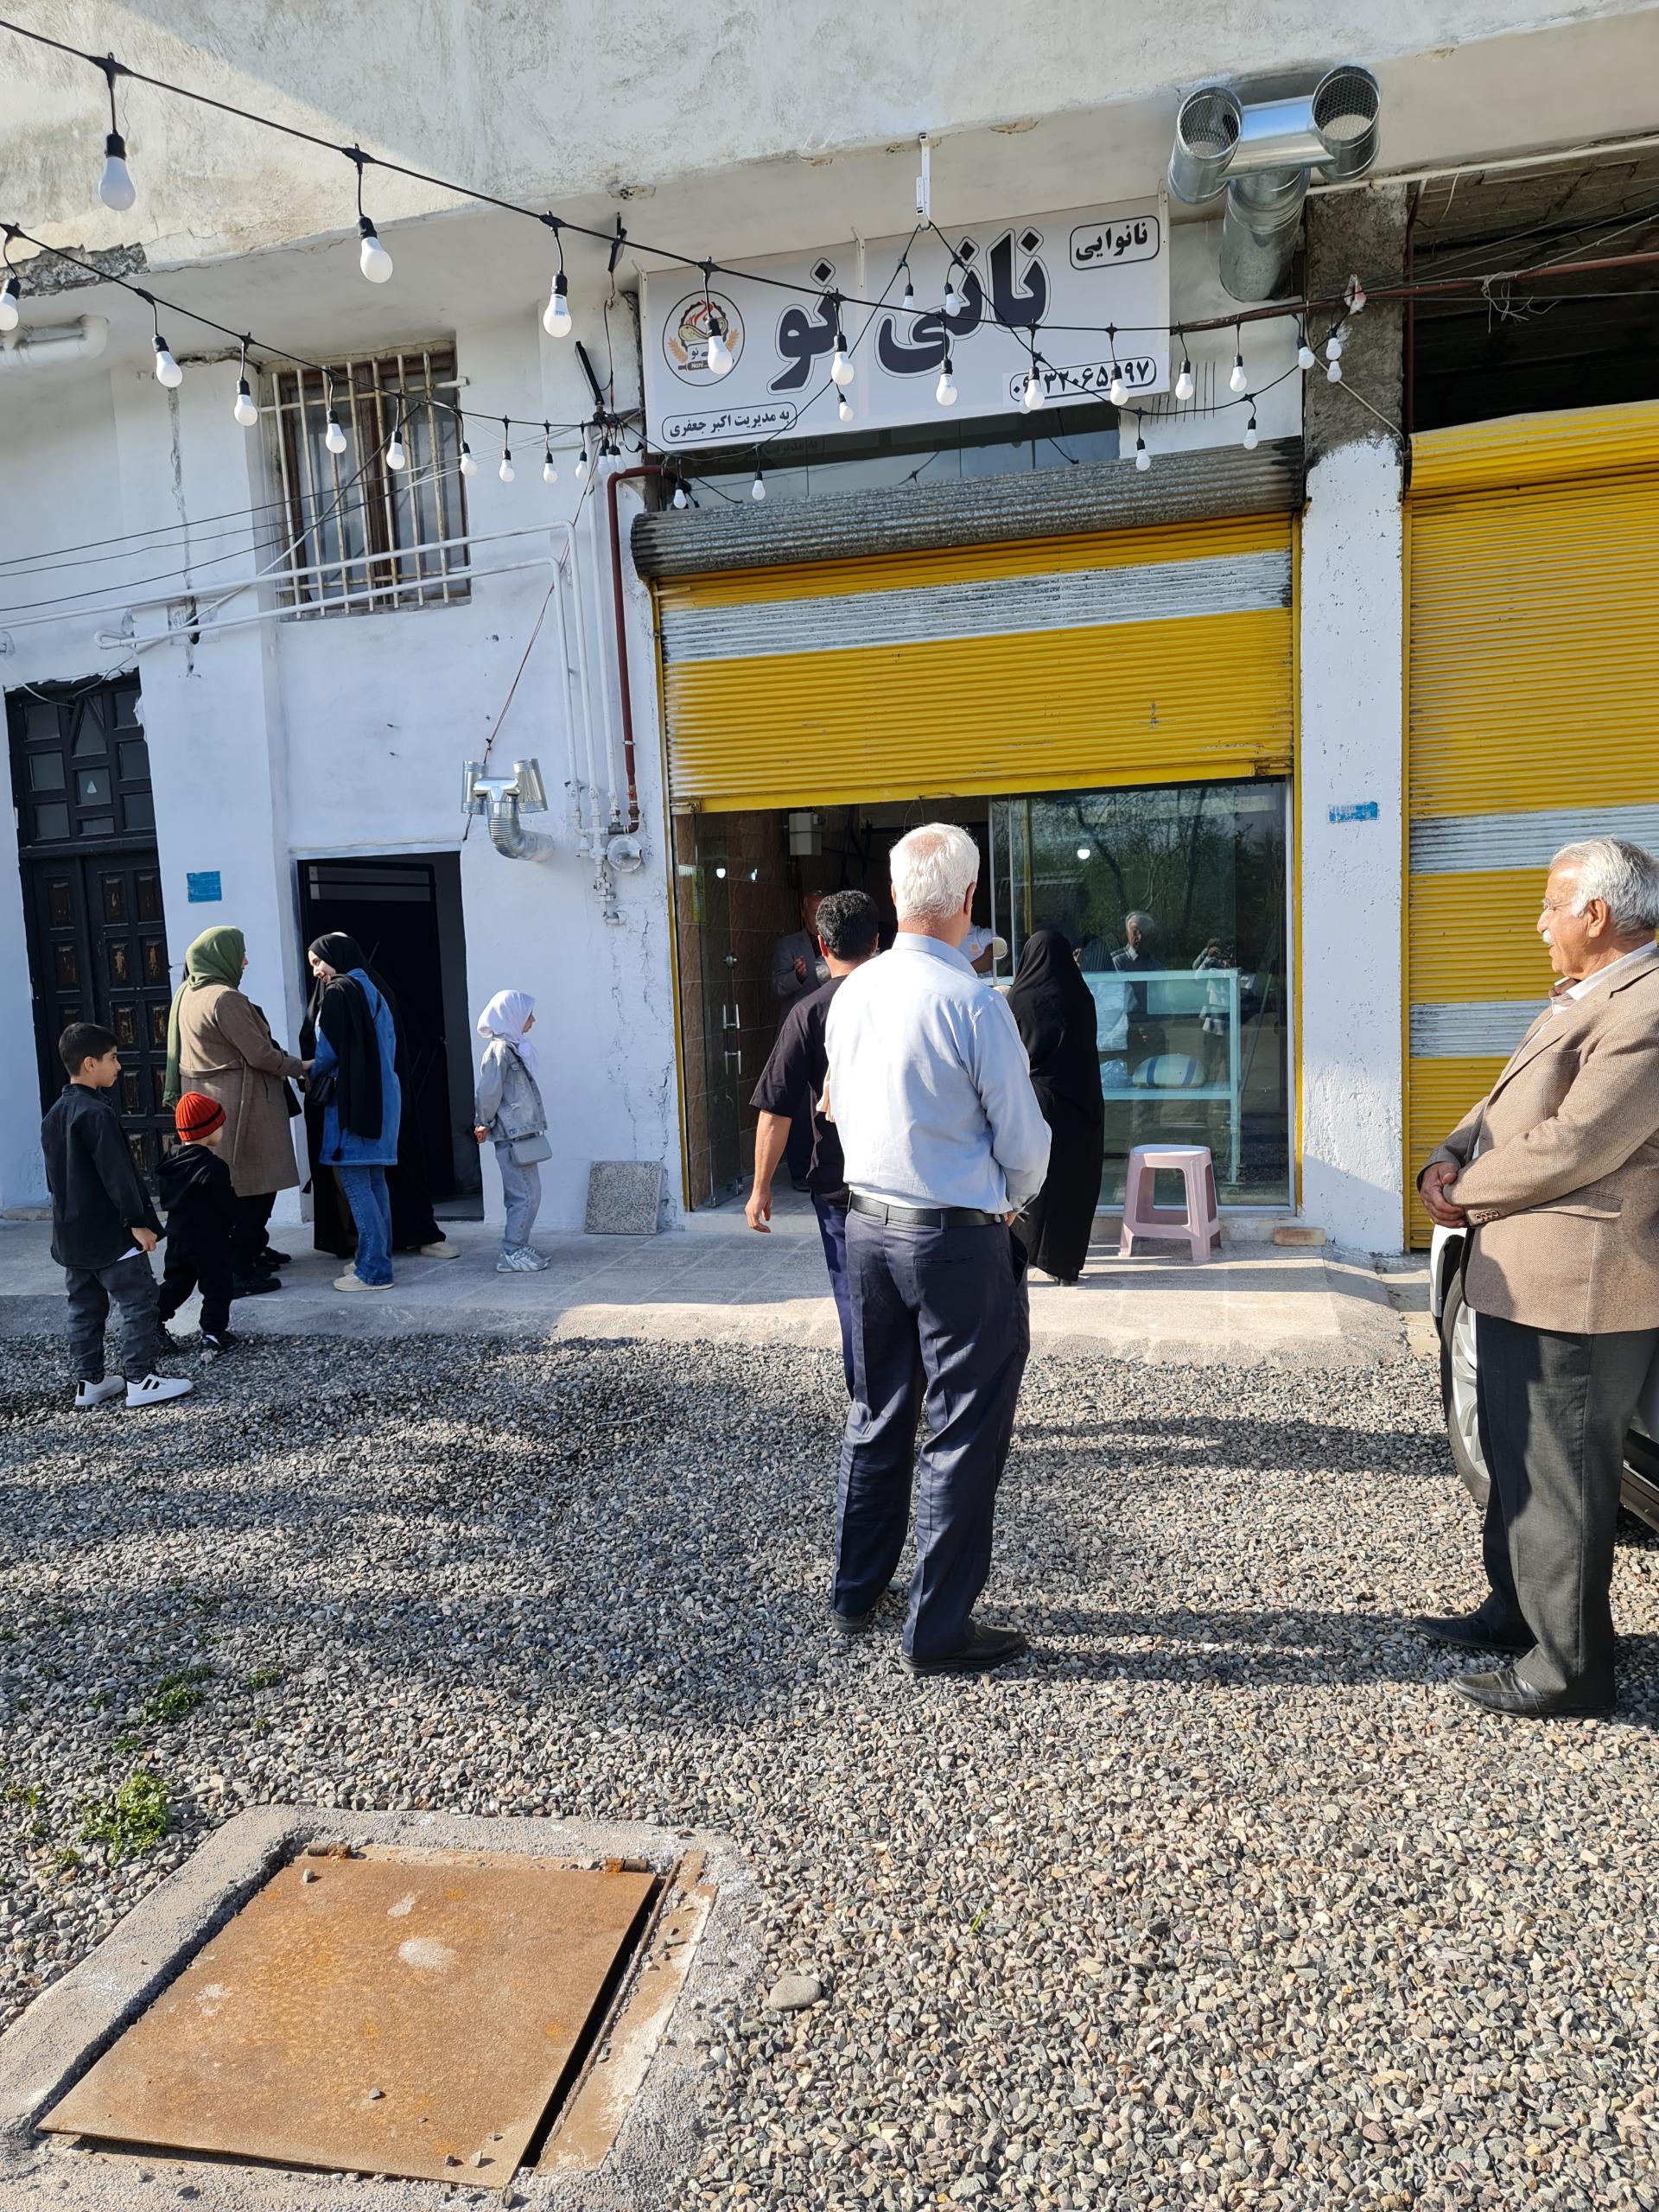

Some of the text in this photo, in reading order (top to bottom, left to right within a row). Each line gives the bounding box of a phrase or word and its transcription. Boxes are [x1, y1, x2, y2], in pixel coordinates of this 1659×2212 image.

[1076, 222, 1147, 261] نانوایی
[770, 231, 1047, 391] نانی نو
[670, 410, 790, 438] به مدیریت اکبر جعفری
